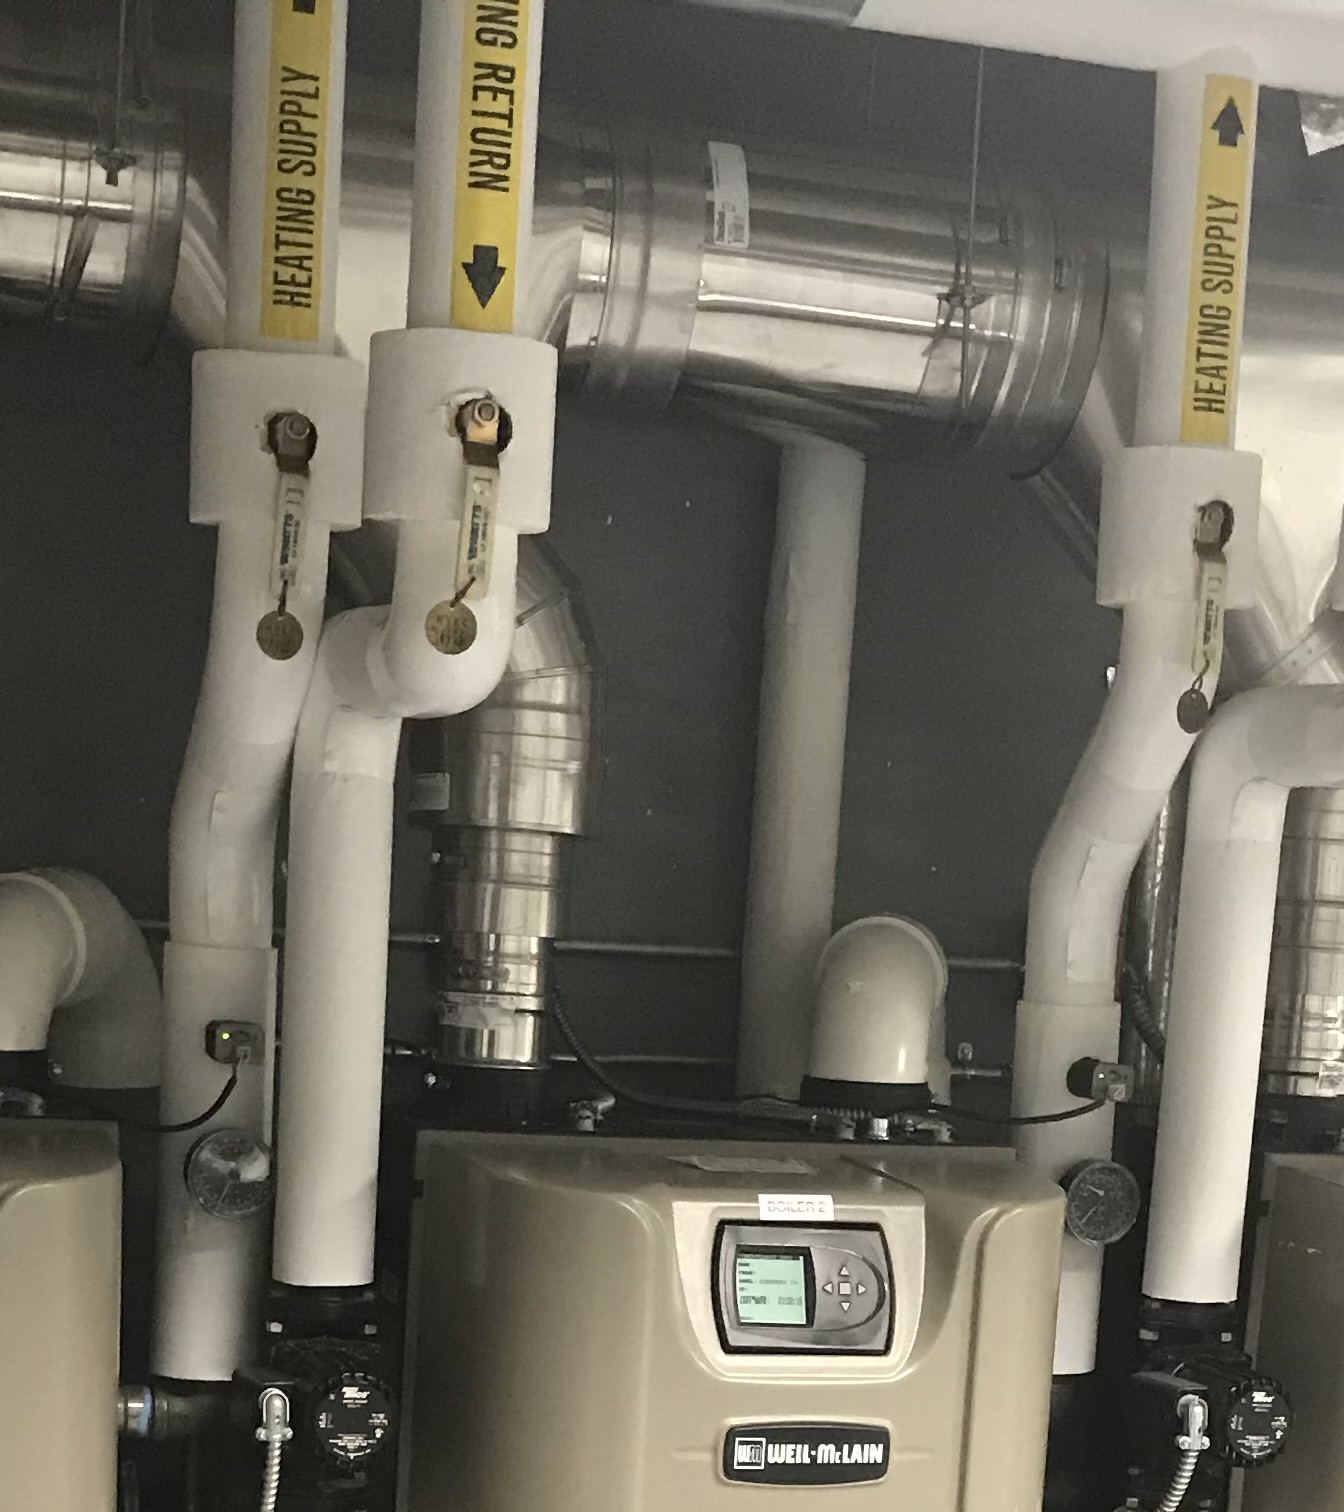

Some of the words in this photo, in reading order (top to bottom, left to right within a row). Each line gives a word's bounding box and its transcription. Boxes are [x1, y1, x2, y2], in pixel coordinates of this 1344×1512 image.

[278, 66, 320, 177] SUPPLY
[468, 62, 517, 194] RETURN
[272, 187, 316, 309] HEATING
[1201, 195, 1240, 295] SUPPLY
[1193, 303, 1232, 414] HEATING
[767, 1200, 815, 1213] BOILER
[818, 1200, 827, 1213] 2
